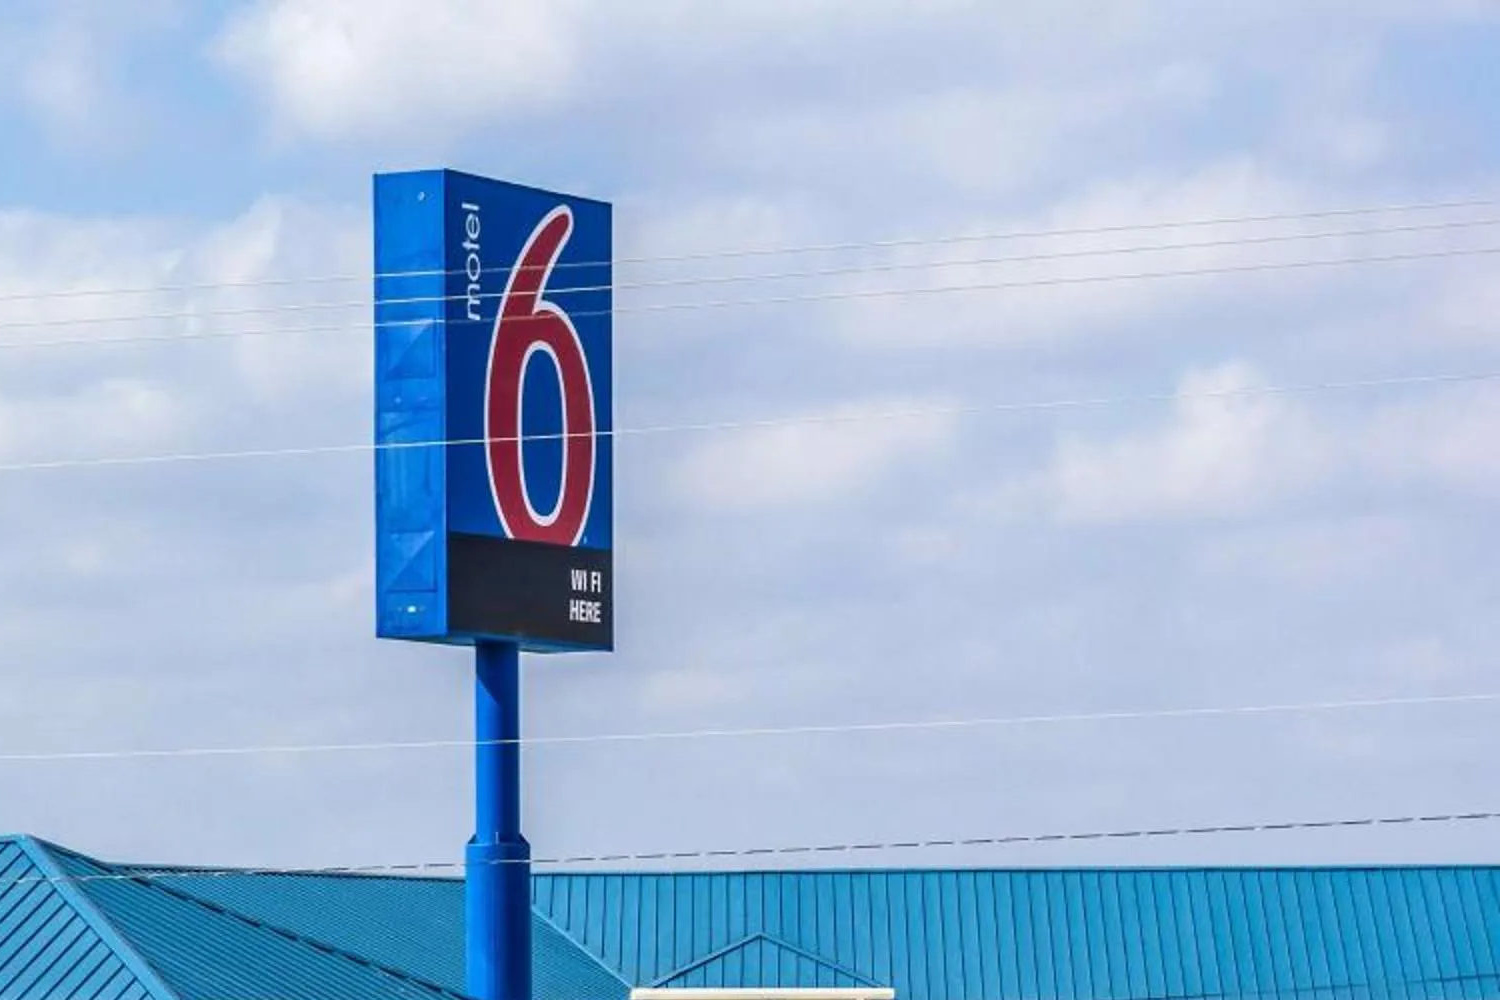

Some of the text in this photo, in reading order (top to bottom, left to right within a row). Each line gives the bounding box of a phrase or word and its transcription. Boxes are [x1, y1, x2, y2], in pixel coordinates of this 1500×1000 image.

[461, 202, 481, 320] motel
[485, 204, 595, 546] 6
[569, 599, 601, 623] HERE
